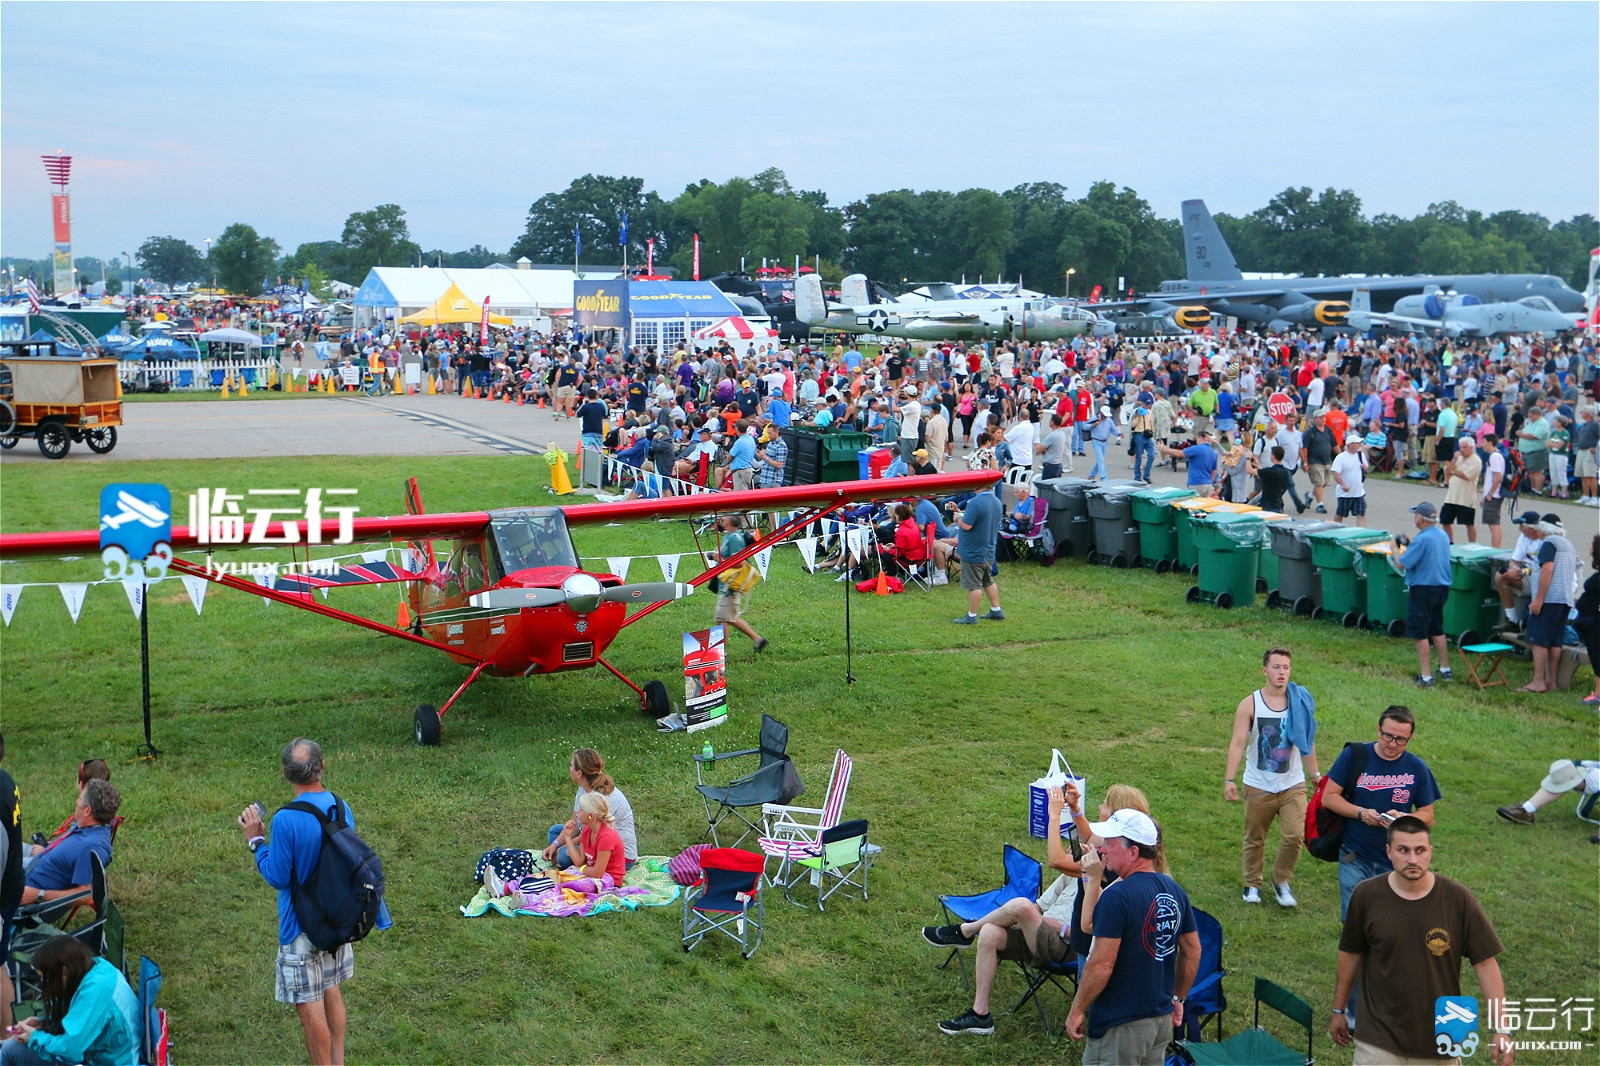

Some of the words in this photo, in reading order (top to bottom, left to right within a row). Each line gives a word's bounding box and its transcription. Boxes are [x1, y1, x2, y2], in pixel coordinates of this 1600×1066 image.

[576, 292, 620, 313] GOODYEAR
[146, 337, 173, 347] NAVY
[1269, 401, 1293, 416] STOP
[1391, 788, 1411, 803] 22
[1149, 919, 1177, 934] ARIAT
